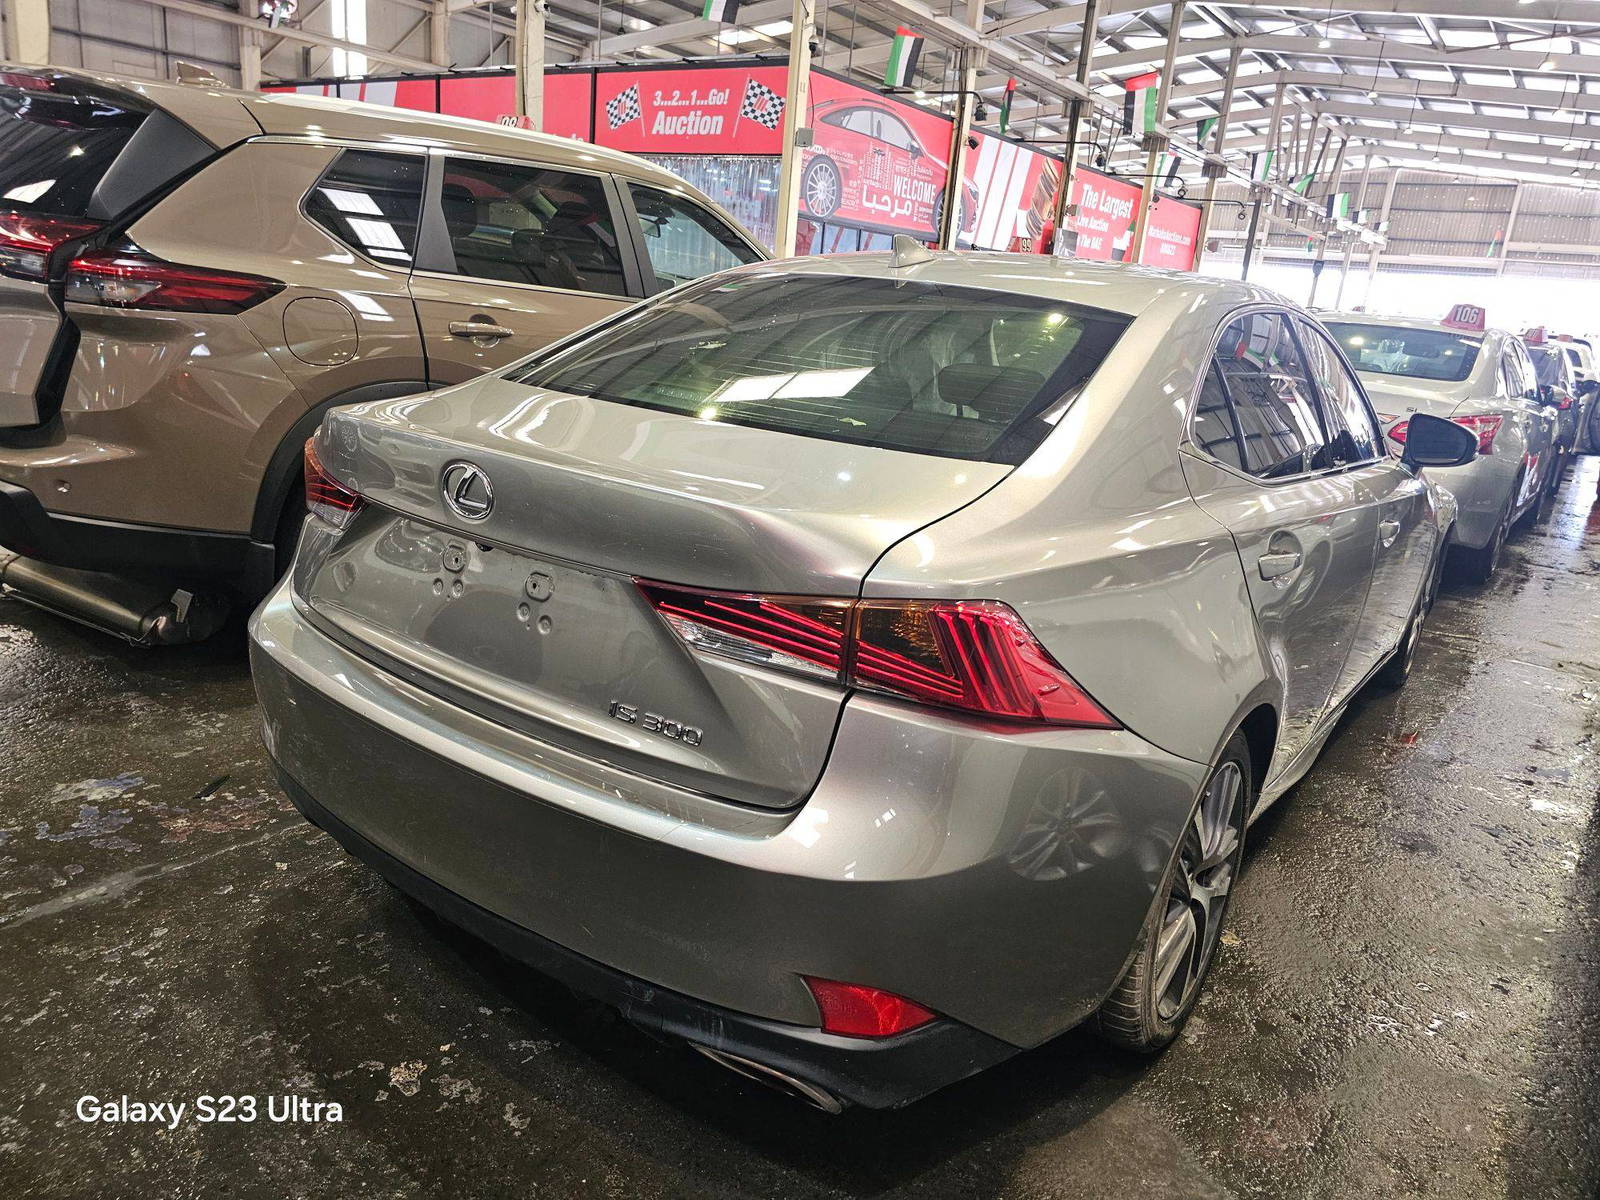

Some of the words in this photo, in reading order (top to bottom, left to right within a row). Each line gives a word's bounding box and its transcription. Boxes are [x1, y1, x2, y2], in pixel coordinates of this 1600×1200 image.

[651, 110, 724, 135] Auction
[862, 184, 913, 219] مرحبا
[893, 174, 937, 205] WELCOME
[1081, 183, 1099, 210] The
[1098, 188, 1135, 220] Largest
[1021, 238, 1032, 252] 99
[1455, 306, 1479, 323] 106
[608, 699, 637, 724] IS
[643, 712, 703, 746] 300
